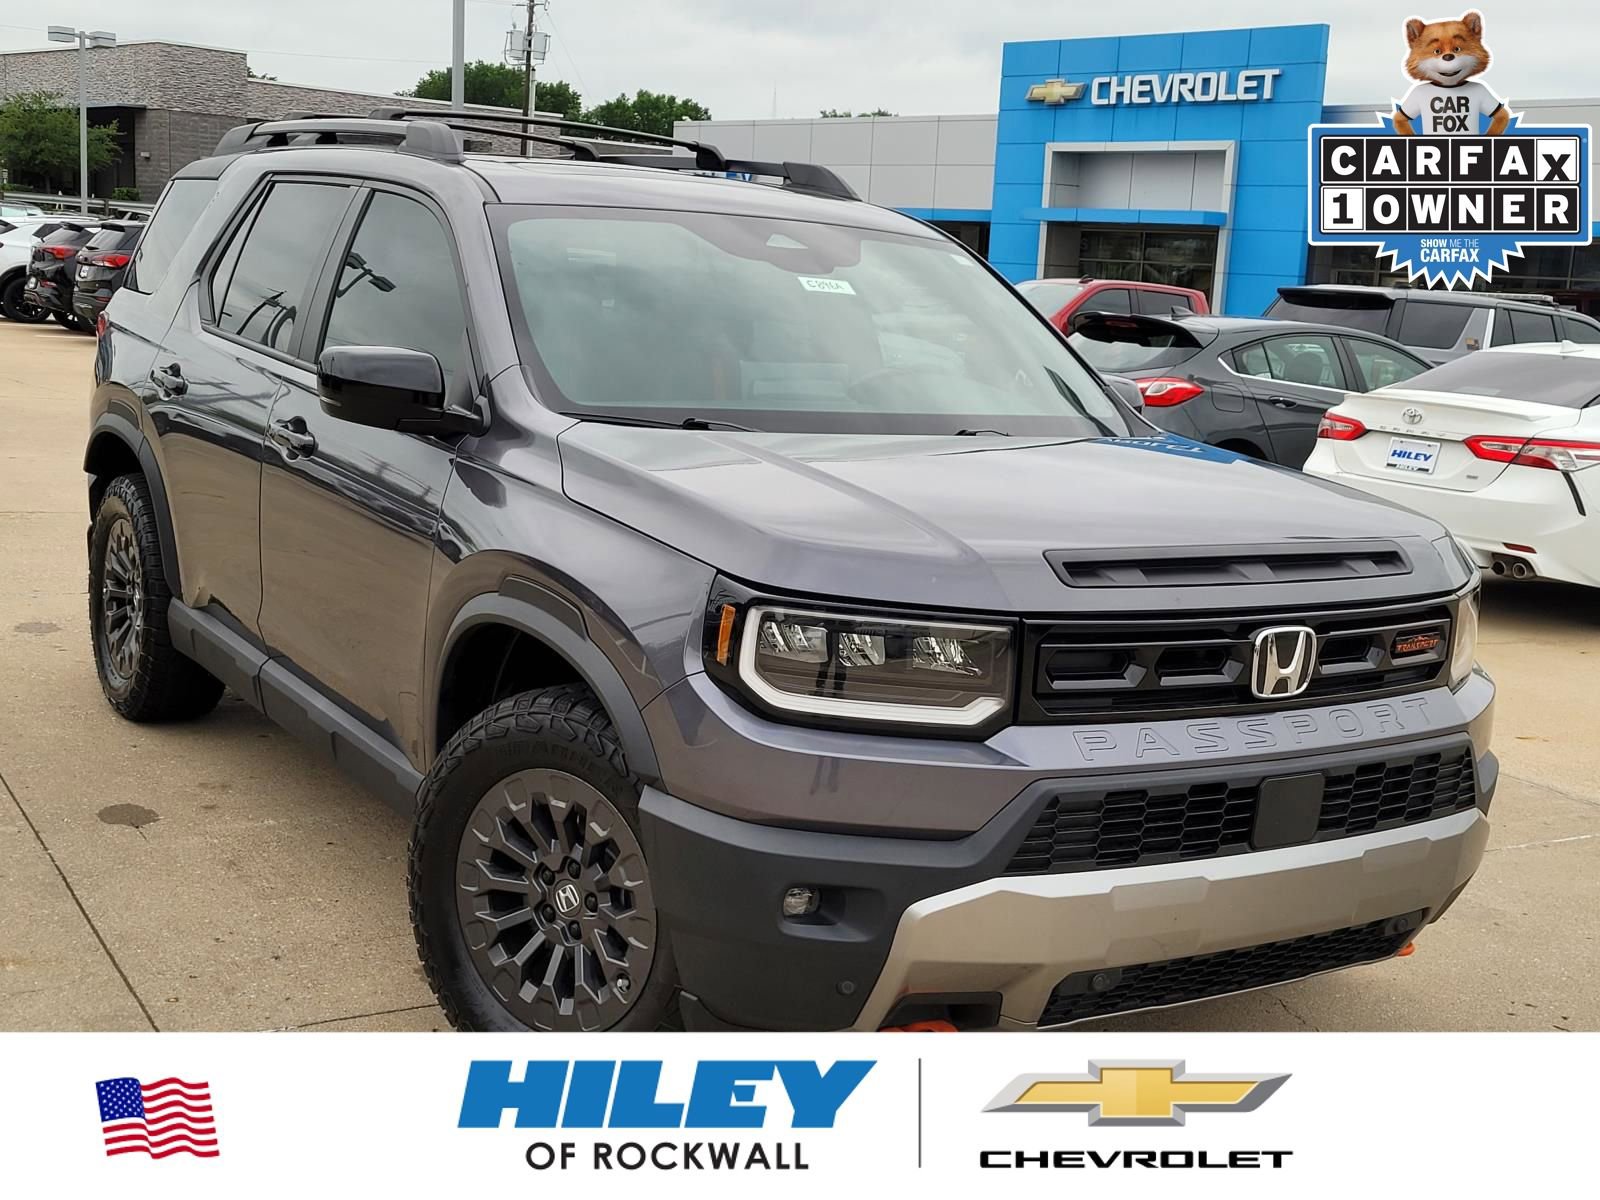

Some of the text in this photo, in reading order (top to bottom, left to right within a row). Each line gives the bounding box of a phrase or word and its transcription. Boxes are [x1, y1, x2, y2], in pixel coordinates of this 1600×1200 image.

[1091, 68, 1281, 106] CHEVROLET
[1391, 449, 1433, 462] HILEY
[1073, 697, 1431, 762] PASSPORT
